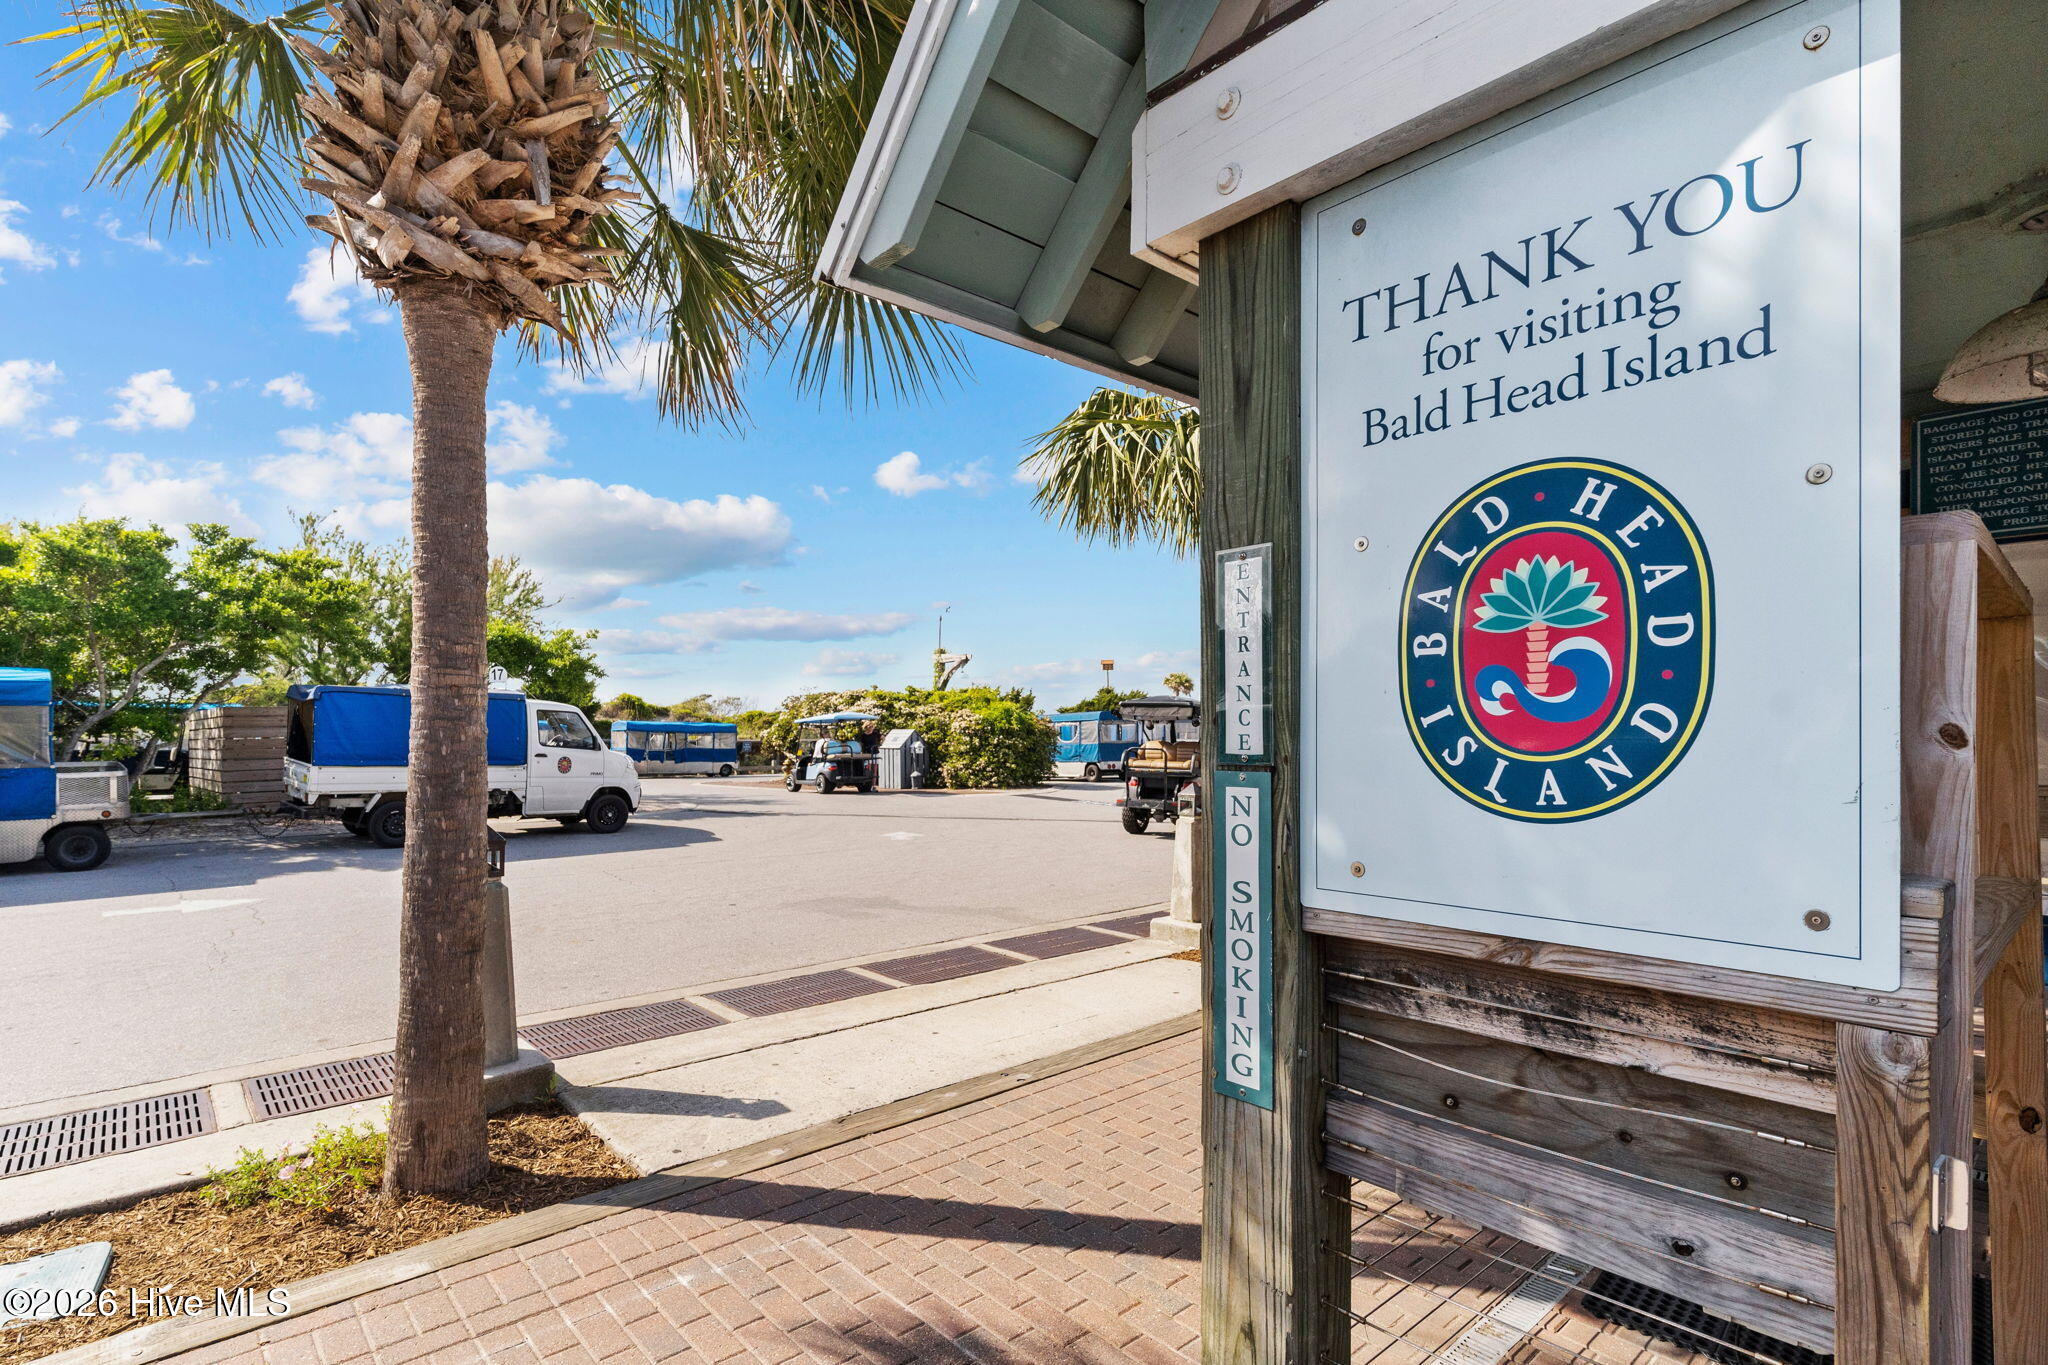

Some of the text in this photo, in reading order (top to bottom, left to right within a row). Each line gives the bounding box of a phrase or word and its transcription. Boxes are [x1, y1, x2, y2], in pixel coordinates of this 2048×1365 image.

[1342, 138, 1812, 343] THANK YOU
[1422, 280, 1681, 376] for visiting
[1362, 303, 1778, 447] Bald Head Island
[1923, 418, 1985, 435] BAGGAGE
[1989, 412, 2019, 423] AND
[1931, 429, 1984, 444] STORED
[1987, 423, 2018, 434] AND
[1927, 441, 2040, 464] ISLAND LIMITED.
[1928, 439, 1983, 454] OWNERS
[1988, 433, 2022, 444] SOLE
[1930, 451, 2048, 474] HEAD ISLAND TR
[1961, 470, 1987, 480] ARE
[1990, 465, 2020, 475] NOT
[1934, 489, 1999, 503] VALUABLE
[1936, 476, 2018, 493] CONCEALED
[1412, 476, 1695, 659] BALD HEAD
[1236, 562, 1252, 751] ENTRANCE
[491, 668, 504, 681] 17
[1420, 702, 1680, 806] ISLAND
[1229, 795, 1255, 1078] NO SMOKING
